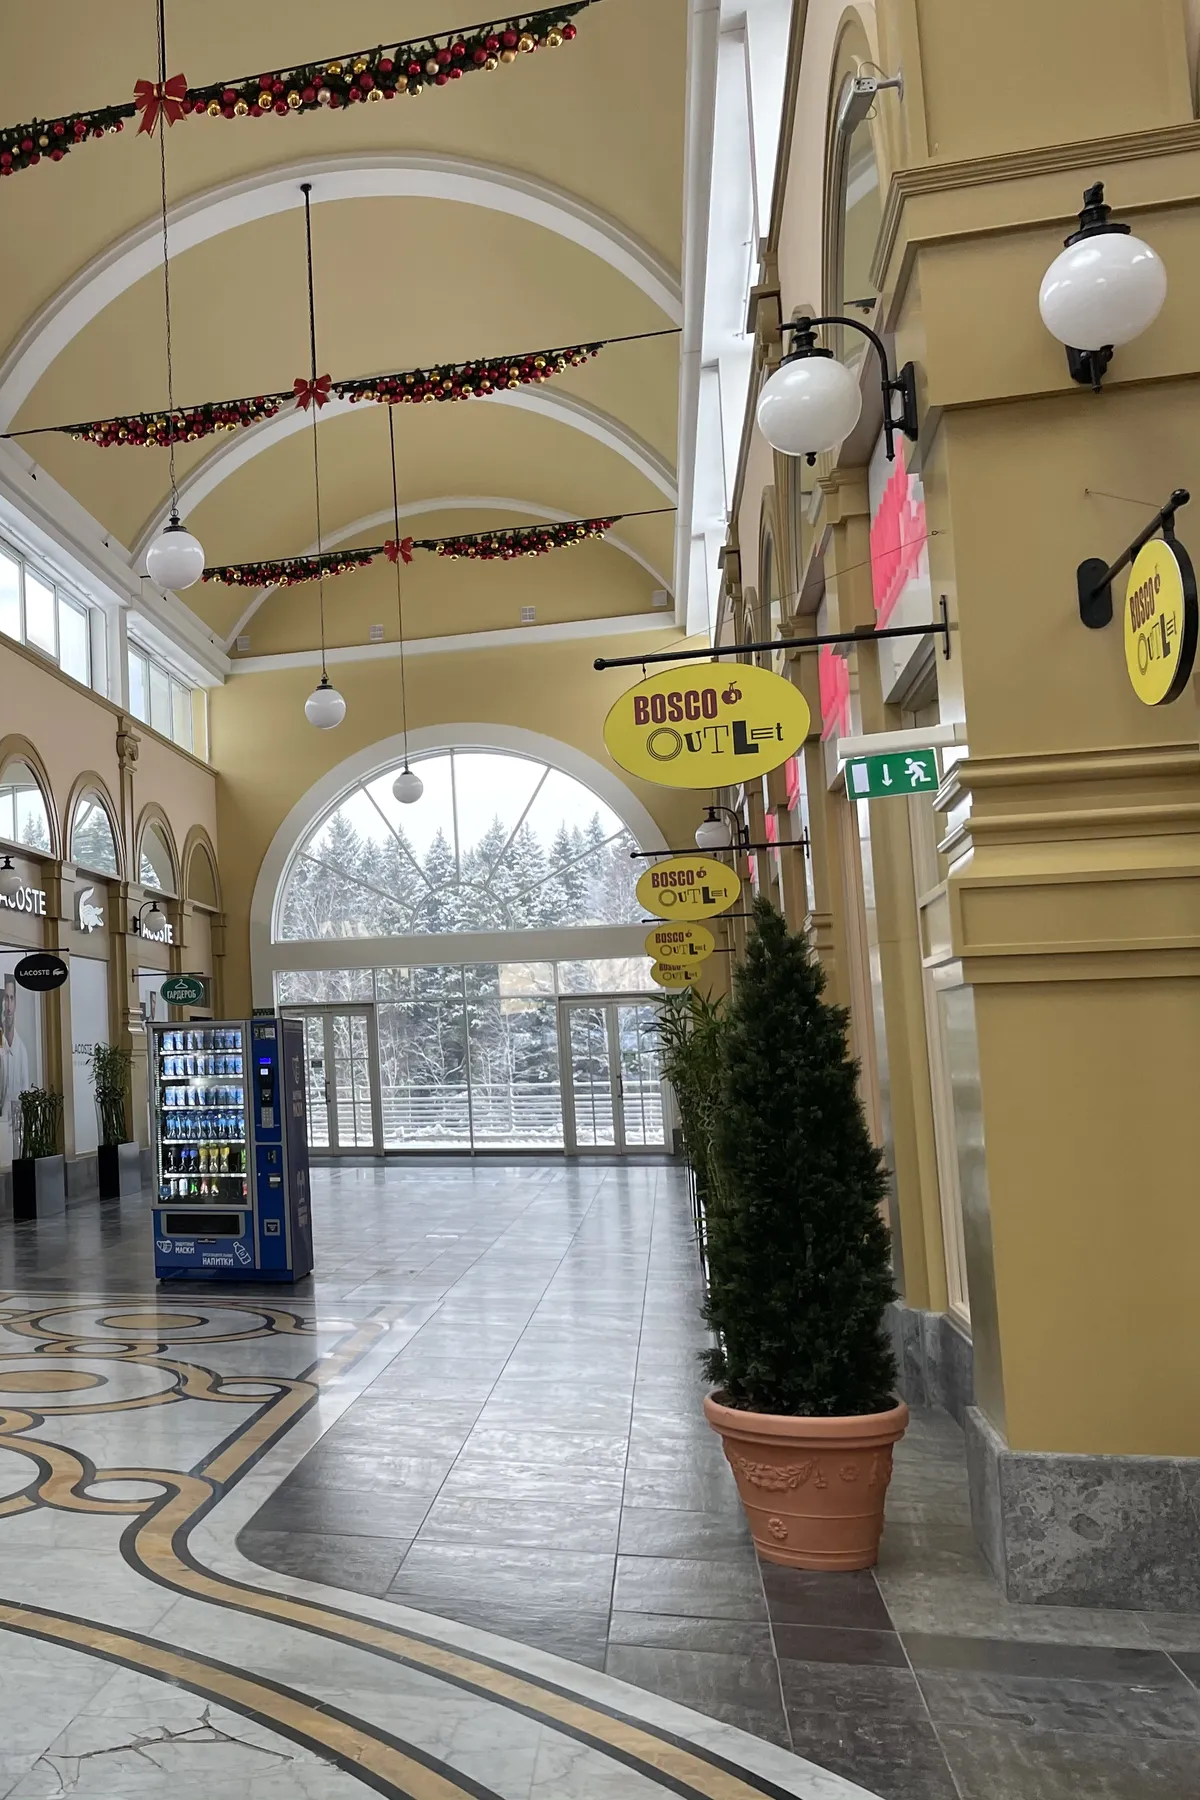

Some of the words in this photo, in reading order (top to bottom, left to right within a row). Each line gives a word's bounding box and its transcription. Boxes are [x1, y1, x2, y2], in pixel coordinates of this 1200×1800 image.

[1129, 576, 1155, 634] BOSCO
[633, 688, 718, 726] BOSCO
[651, 870, 695, 888] BOSCO
[655, 931, 685, 944] BOSCO
[19, 969, 50, 977] LACOSTE
[166, 989, 197, 1000] ГАРДЕРОБ
[175, 1246, 195, 1254] МАСКИ
[202, 1257, 234, 1266] НАПИТКИ
